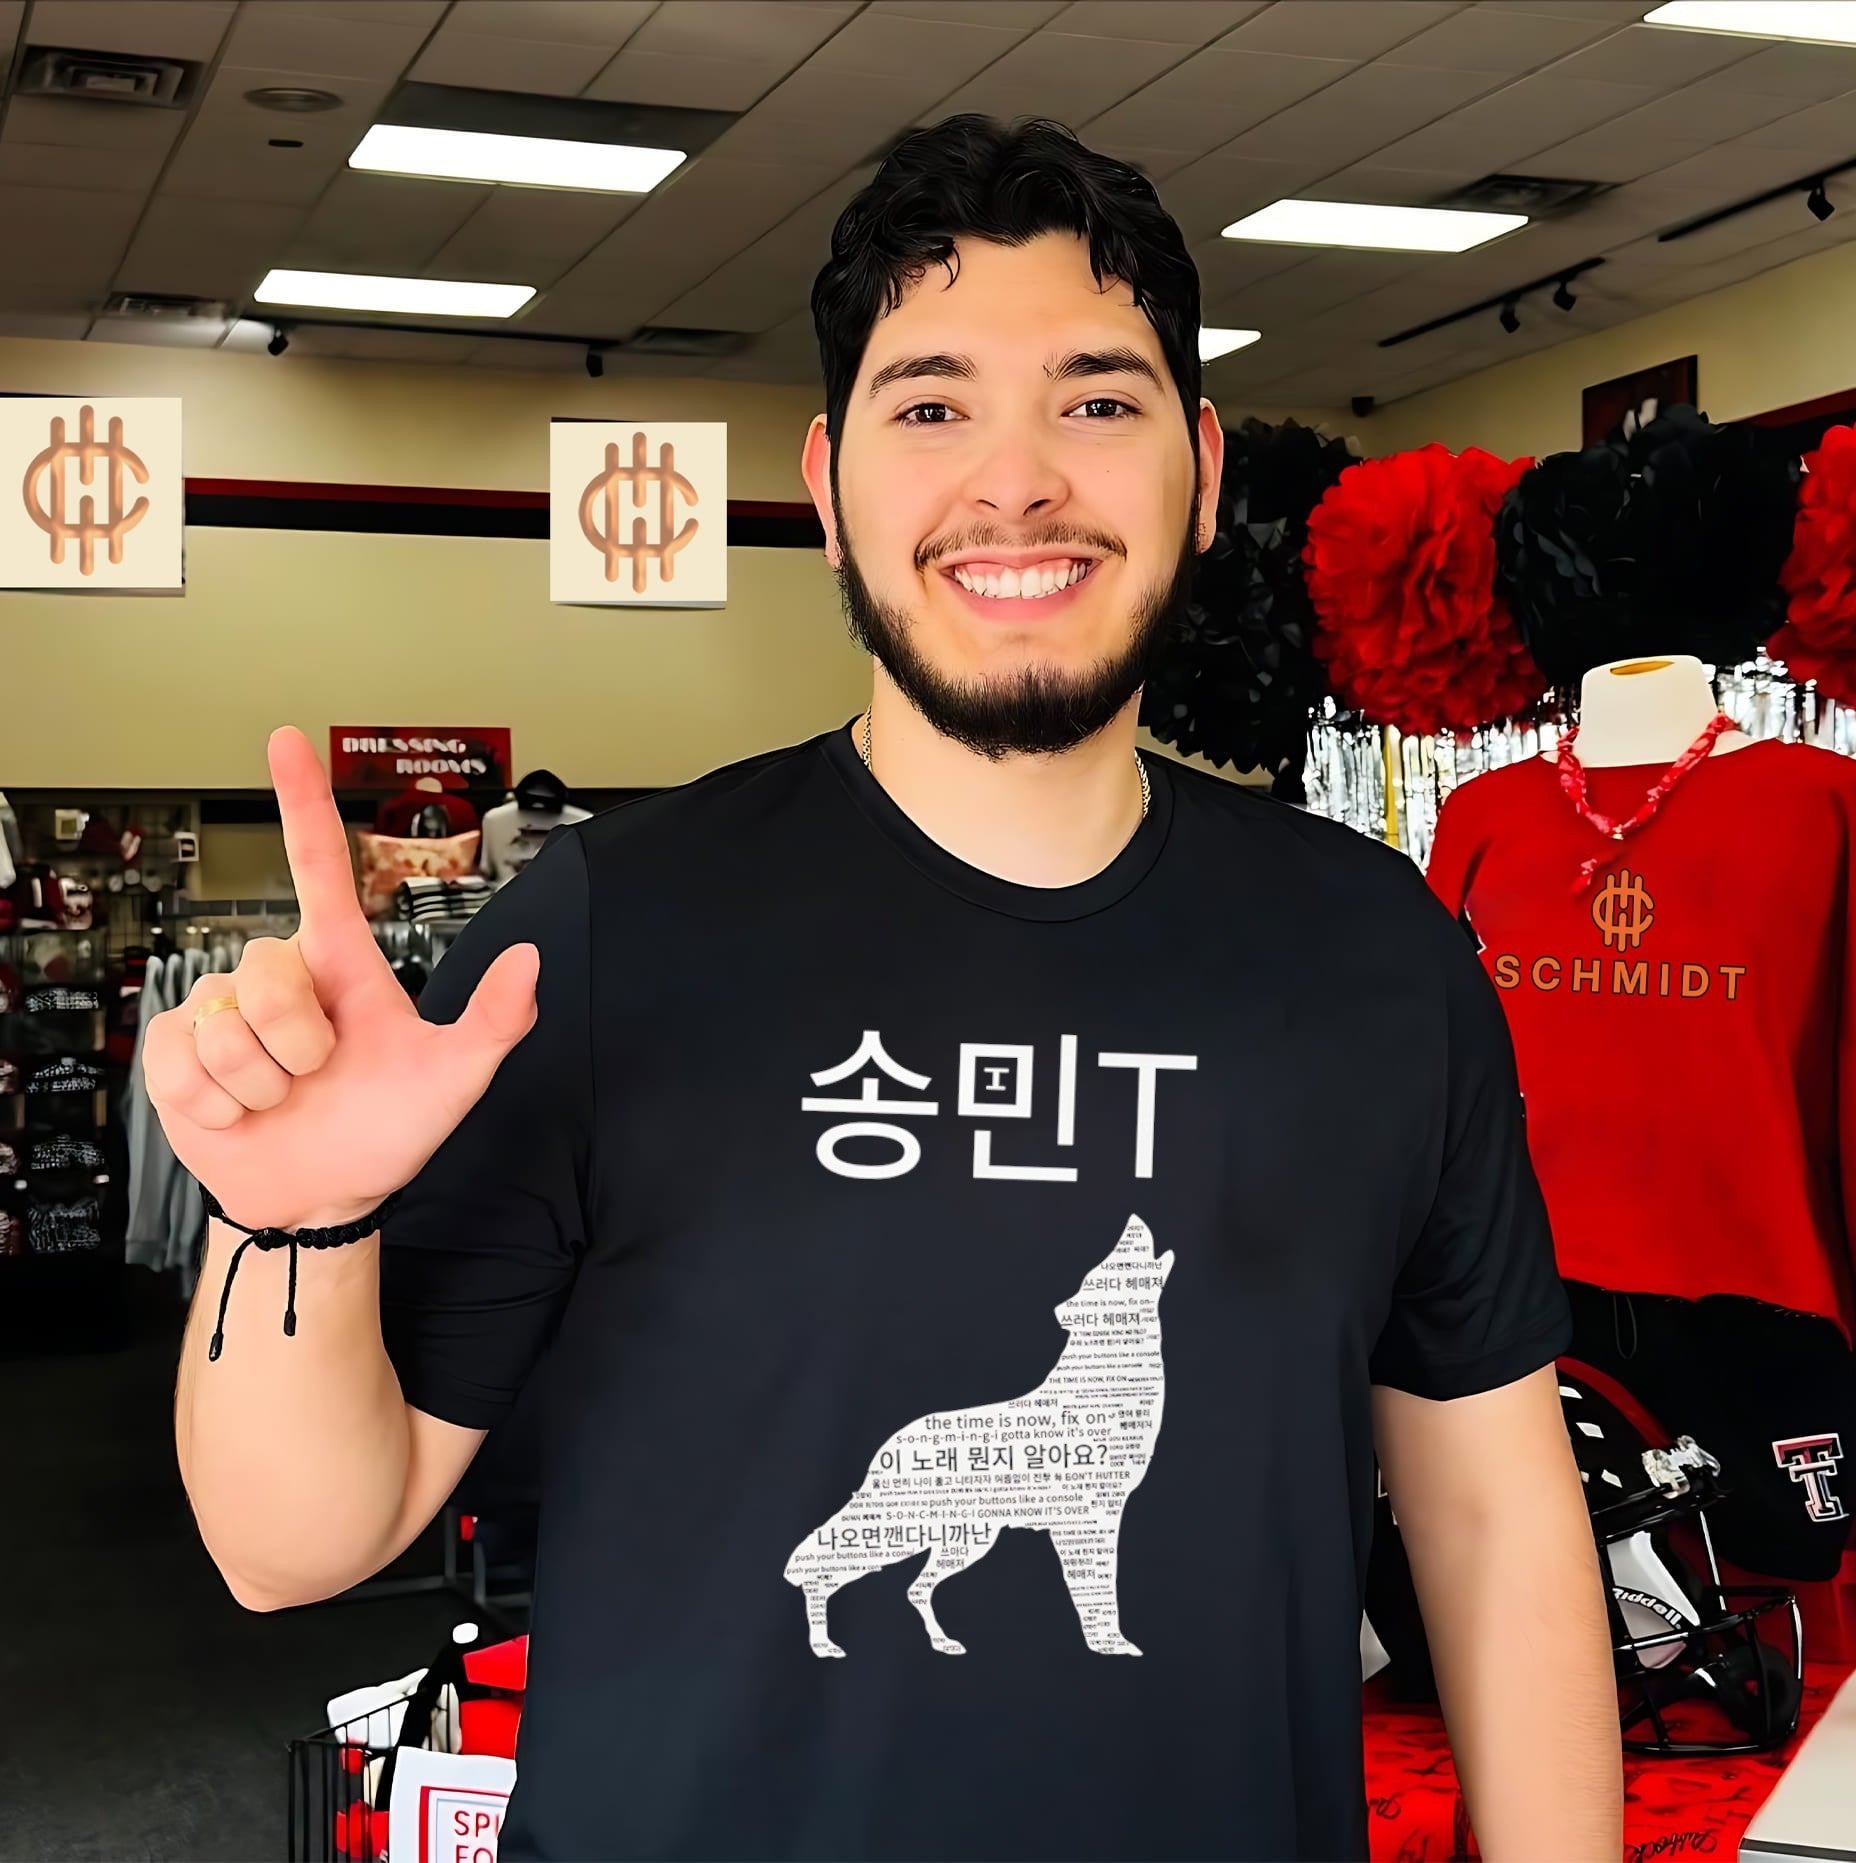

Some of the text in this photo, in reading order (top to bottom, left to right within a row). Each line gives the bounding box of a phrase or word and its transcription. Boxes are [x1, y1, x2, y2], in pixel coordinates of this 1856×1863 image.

[342, 737, 467, 754] DRESSING
[396, 758, 487, 775] ROOMS
[1494, 953, 1748, 1001] SCHMIDT
[1066, 1299, 1079, 1307] the
[1081, 1299, 1098, 1307] time
[1100, 1299, 1107, 1307] is
[1128, 1298, 1139, 1306] fix
[925, 1416, 952, 1430] the
[957, 1414, 994, 1429] time
[999, 1413, 1011, 1427] is
[1016, 1415, 1056, 1428] now,
[1061, 1411, 1079, 1425] fix
[896, 1427, 1112, 1445] s-o-n-g-m-i-n-g-i gotta know it's over
[880, 1444, 1108, 1474] 이 노래 뭔지 알아요?
[930, 1497, 952, 1508] push
[954, 1498, 976, 1508] your
[979, 1496, 1017, 1505] buttons
[1019, 1494, 1036, 1503] like
[1046, 1493, 1083, 1502] console
[977, 1509, 1011, 1518] GONNA
[1014, 1507, 1042, 1517] KNOW
[1045, 1507, 1062, 1516] IT'S
[1064, 1506, 1089, 1515] OVER
[817, 1522, 992, 1550] 나오면깬다니까난
[795, 1552, 815, 1562] push
[817, 1552, 834, 1562] your
[837, 1550, 867, 1560] buttons
[869, 1549, 884, 1558] like
[787, 1566, 803, 1575] push
[805, 1565, 819, 1574] your
[821, 1563, 847, 1572] buttons
[848, 1563, 860, 1571] like
